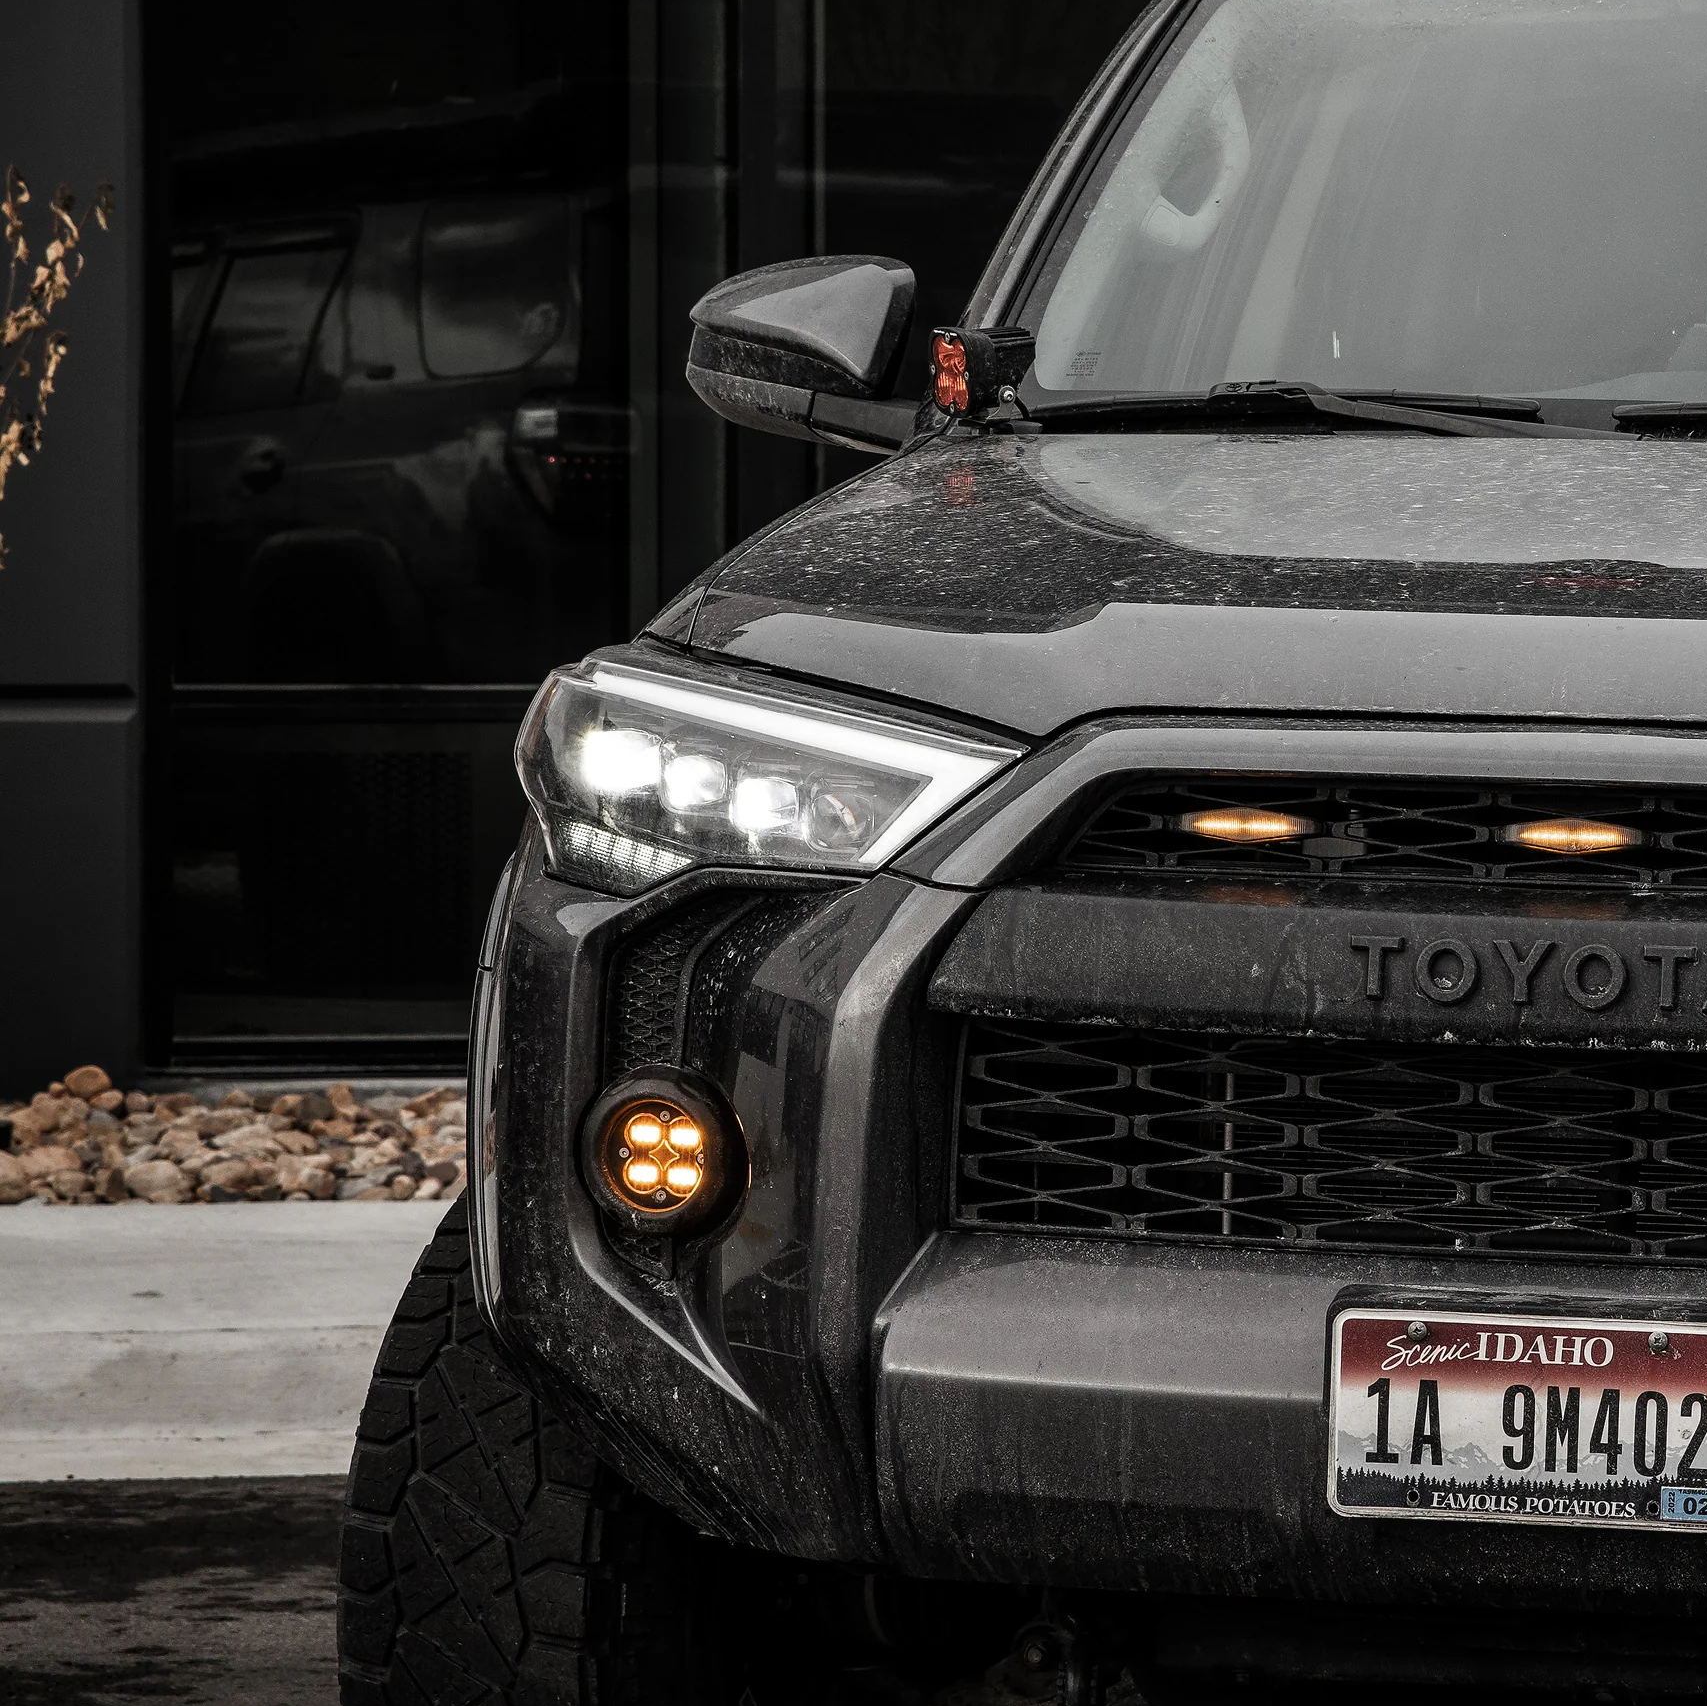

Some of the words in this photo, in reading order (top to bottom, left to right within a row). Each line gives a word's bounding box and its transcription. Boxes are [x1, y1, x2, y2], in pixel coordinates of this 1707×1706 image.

[1381, 1334, 1475, 1371] Scenic
[1474, 1331, 1614, 1367] IDAHO
[1365, 1378, 1443, 1466] 1A
[1430, 1492, 1519, 1513] FAMOUS
[1524, 1496, 1637, 1519] POTATOES
[1667, 1491, 1676, 1514] 2022
